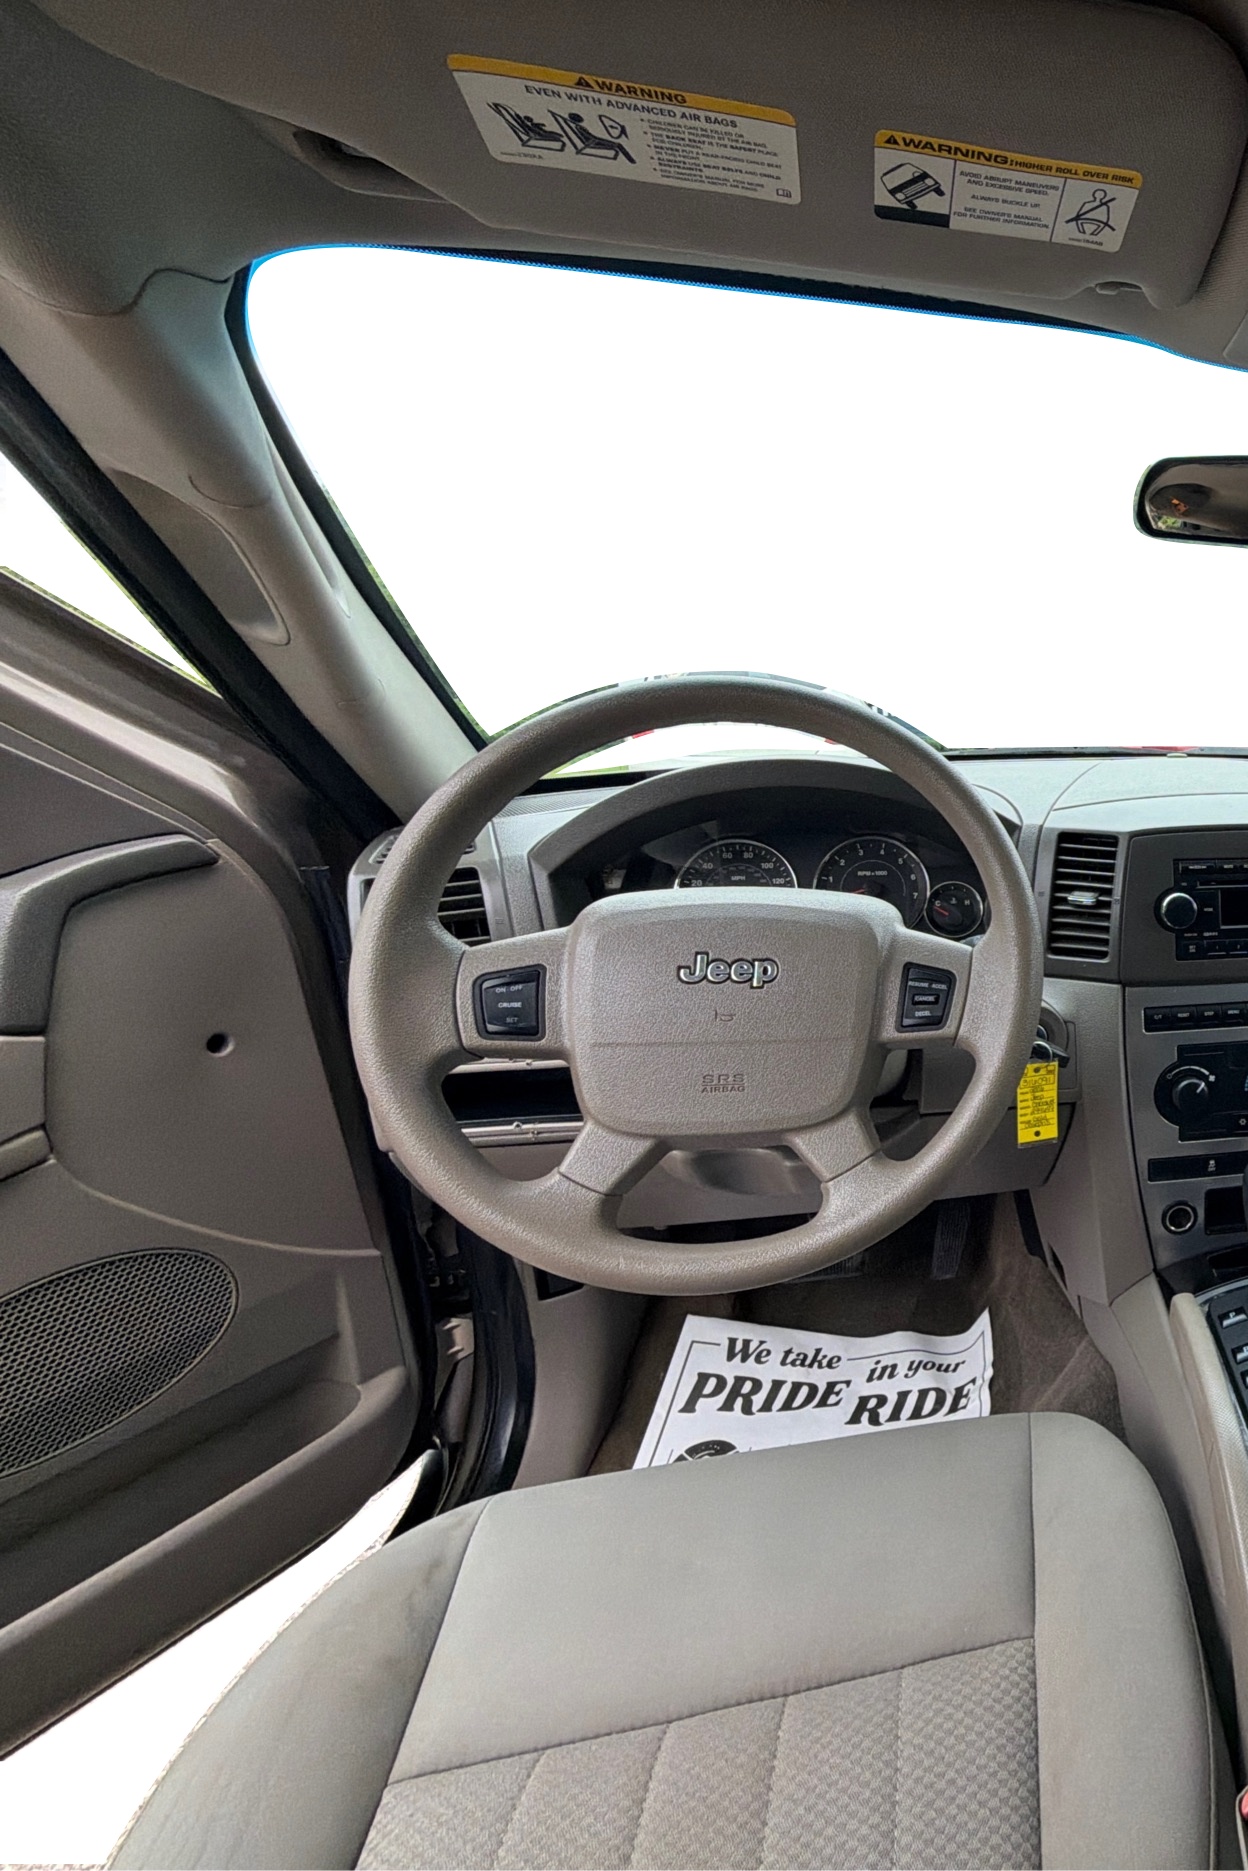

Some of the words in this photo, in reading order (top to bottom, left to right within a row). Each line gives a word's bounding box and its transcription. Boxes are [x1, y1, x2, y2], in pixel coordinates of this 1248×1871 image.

[594, 79, 687, 104] WARNING
[524, 85, 562, 100] EVEN
[564, 91, 602, 105] WITH
[606, 97, 676, 118] ADVANCED
[680, 112, 701, 122] AIR
[704, 115, 737, 128] BAGS
[960, 170, 982, 179] AVOID
[983, 175, 1013, 184] ABRUPT
[1015, 180, 1060, 191] MANEUVERS
[1014, 160, 1052, 172] HIGHER
[1055, 166, 1080, 176] ROLL
[1082, 170, 1109, 180] OVER
[1111, 173, 1134, 184] RISK
[985, 182, 1023, 192] EXCESSIVE
[970, 194, 1000, 203] ALWAYS
[1001, 198, 1028, 207] BUCKLE
[969, 214, 1000, 222] FURTHER
[979, 209, 1012, 218] OWNER'S
[1014, 214, 1043, 222] MANUAL
[677, 952, 779, 989] Jeep
[701, 1086, 745, 1094] AIRBAG
[702, 1073, 744, 1084] SRS
[725, 1336, 772, 1364] We
[779, 1347, 842, 1370] take
[865, 1358, 899, 1383] in
[903, 1357, 966, 1379] your
[678, 1371, 852, 1417] PRIDE
[844, 1377, 977, 1426] RIDE
